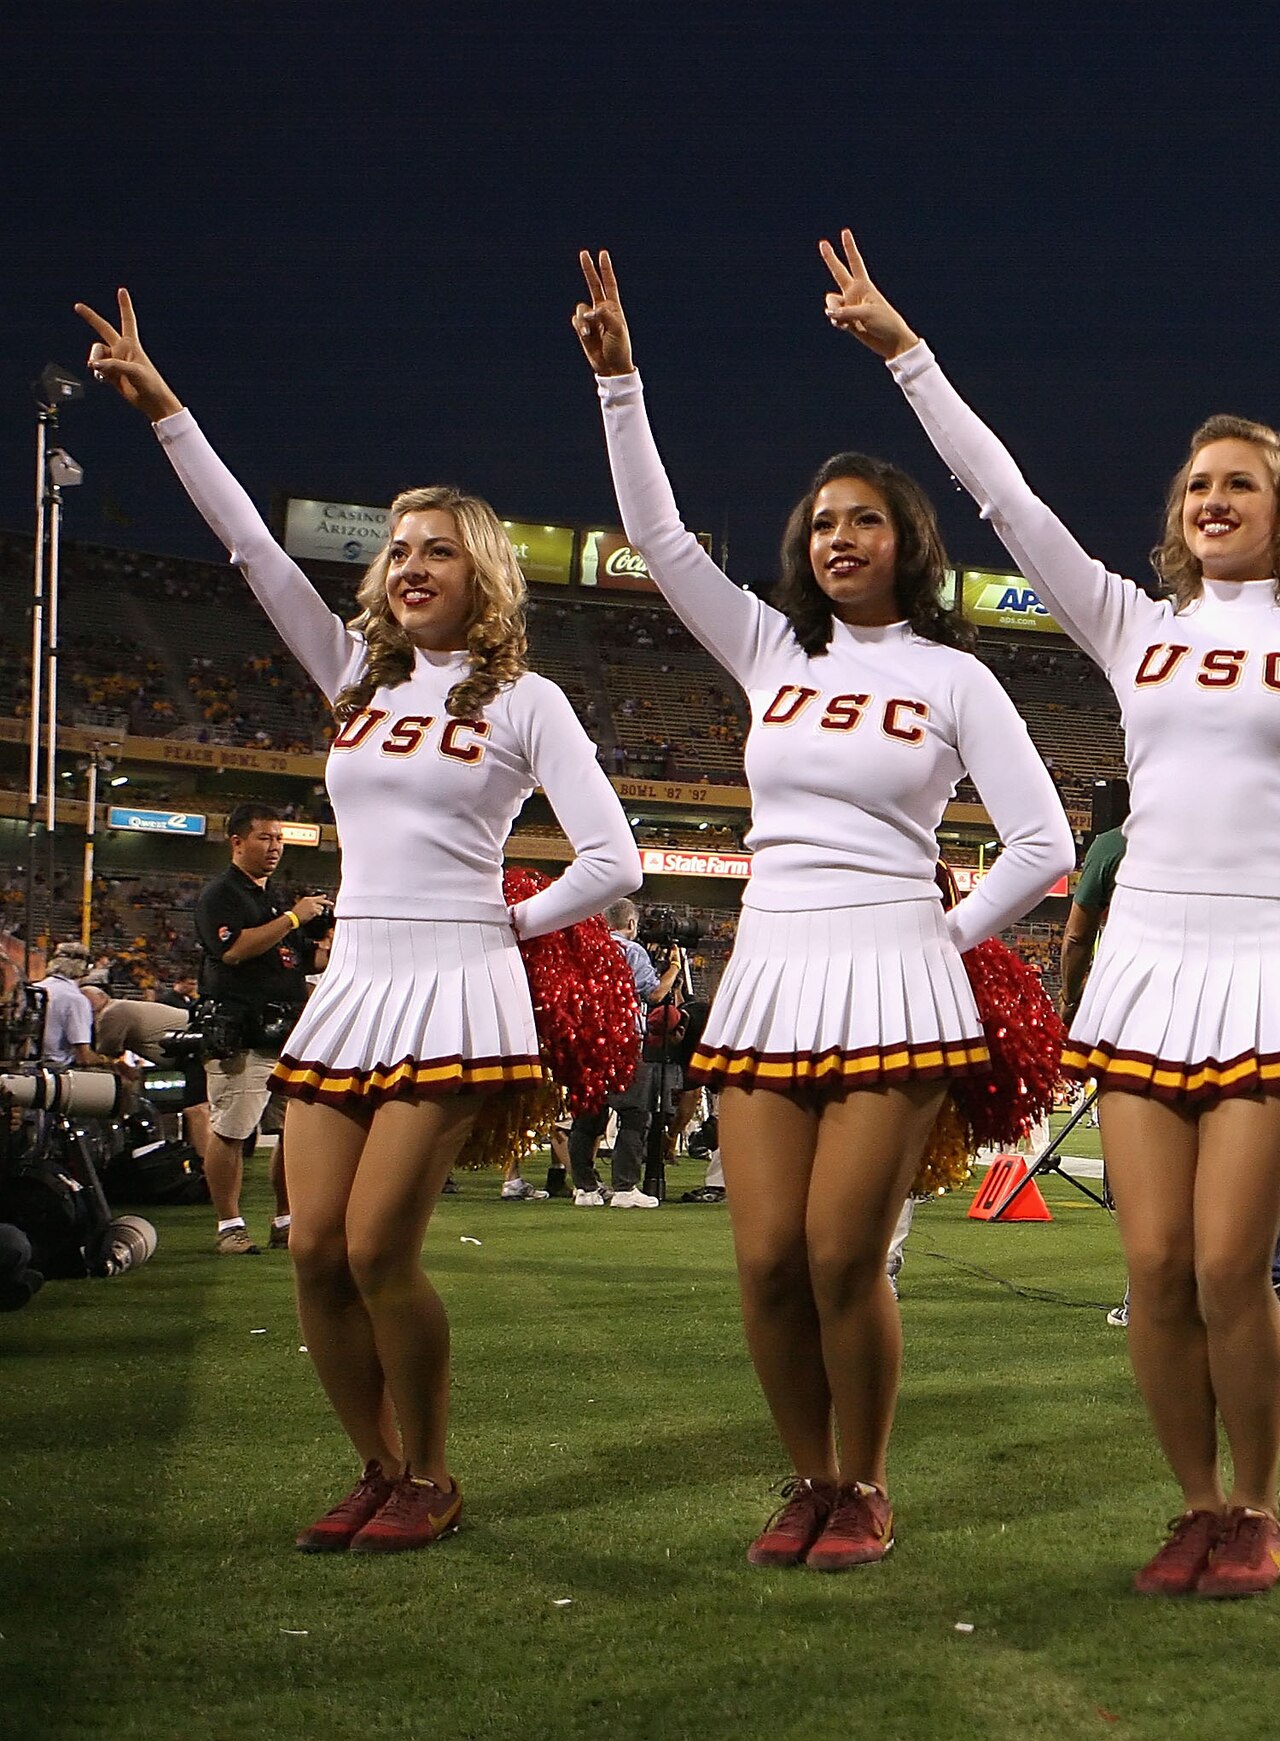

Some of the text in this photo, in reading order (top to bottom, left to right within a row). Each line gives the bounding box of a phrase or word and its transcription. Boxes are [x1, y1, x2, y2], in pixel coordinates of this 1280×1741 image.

[999, 616, 1037, 626] aps.com
[762, 684, 930, 746] USC
[331, 706, 493, 766] USC
[619, 783, 657, 798] BOWL
[663, 854, 749, 875] State Farm
[975, 1158, 1014, 1211] 10
